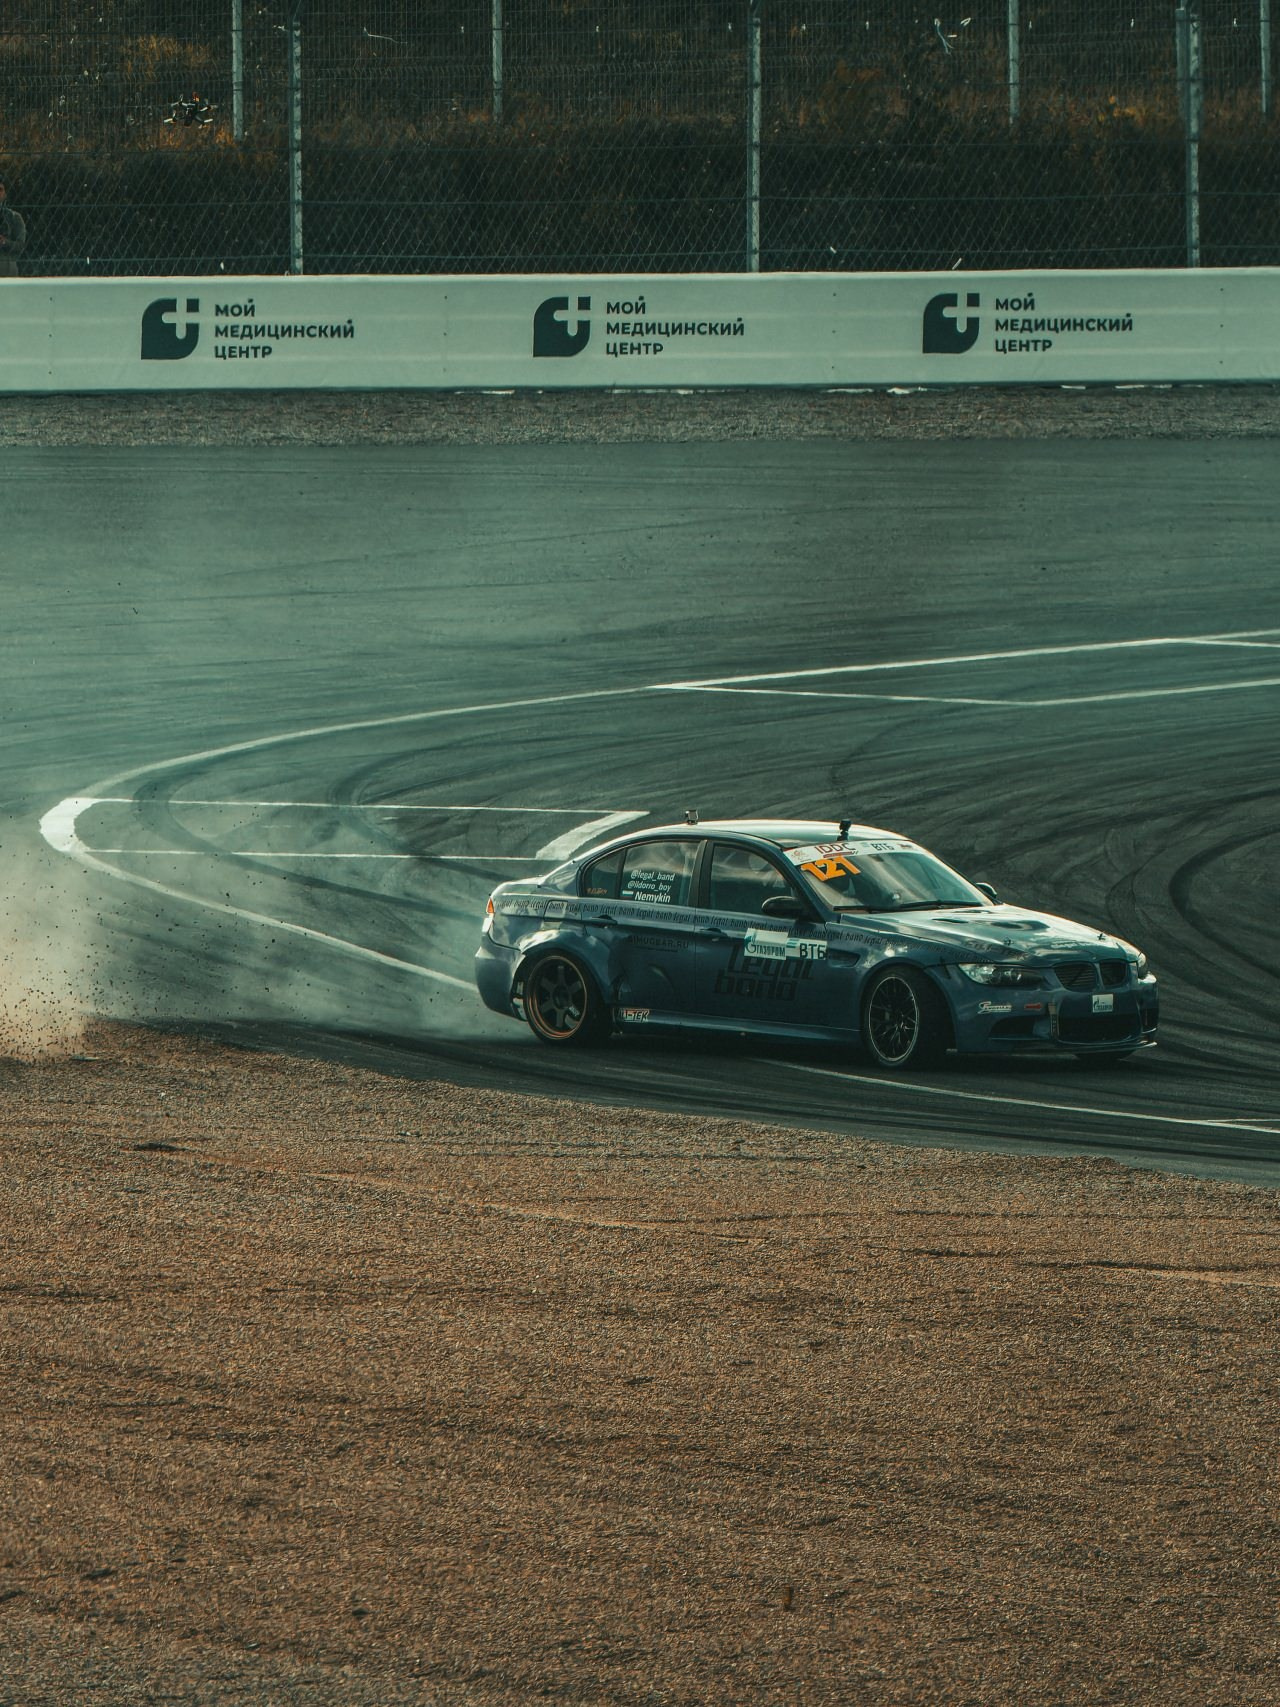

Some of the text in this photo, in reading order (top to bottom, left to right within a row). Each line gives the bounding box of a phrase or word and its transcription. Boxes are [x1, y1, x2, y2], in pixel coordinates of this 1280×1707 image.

[214, 298, 256, 318] МОЙ
[606, 295, 646, 315] МОЙ
[995, 291, 1036, 312] МОЙ
[214, 318, 355, 341] МЕДИЦИНСКИЙ
[606, 316, 745, 338] МЕДИЦИНСКИЙ
[994, 311, 1134, 335] МЕДИЦИНСКИЙ
[214, 345, 273, 361] ЦЕНТР
[605, 341, 664, 358] ЦЕНТР
[994, 338, 1053, 355] ЦЕНТР
[814, 842, 857, 855] IDDC
[800, 855, 861, 882] 121
[634, 891, 671, 905] Nemykin
[800, 943, 827, 960] ВТБ
